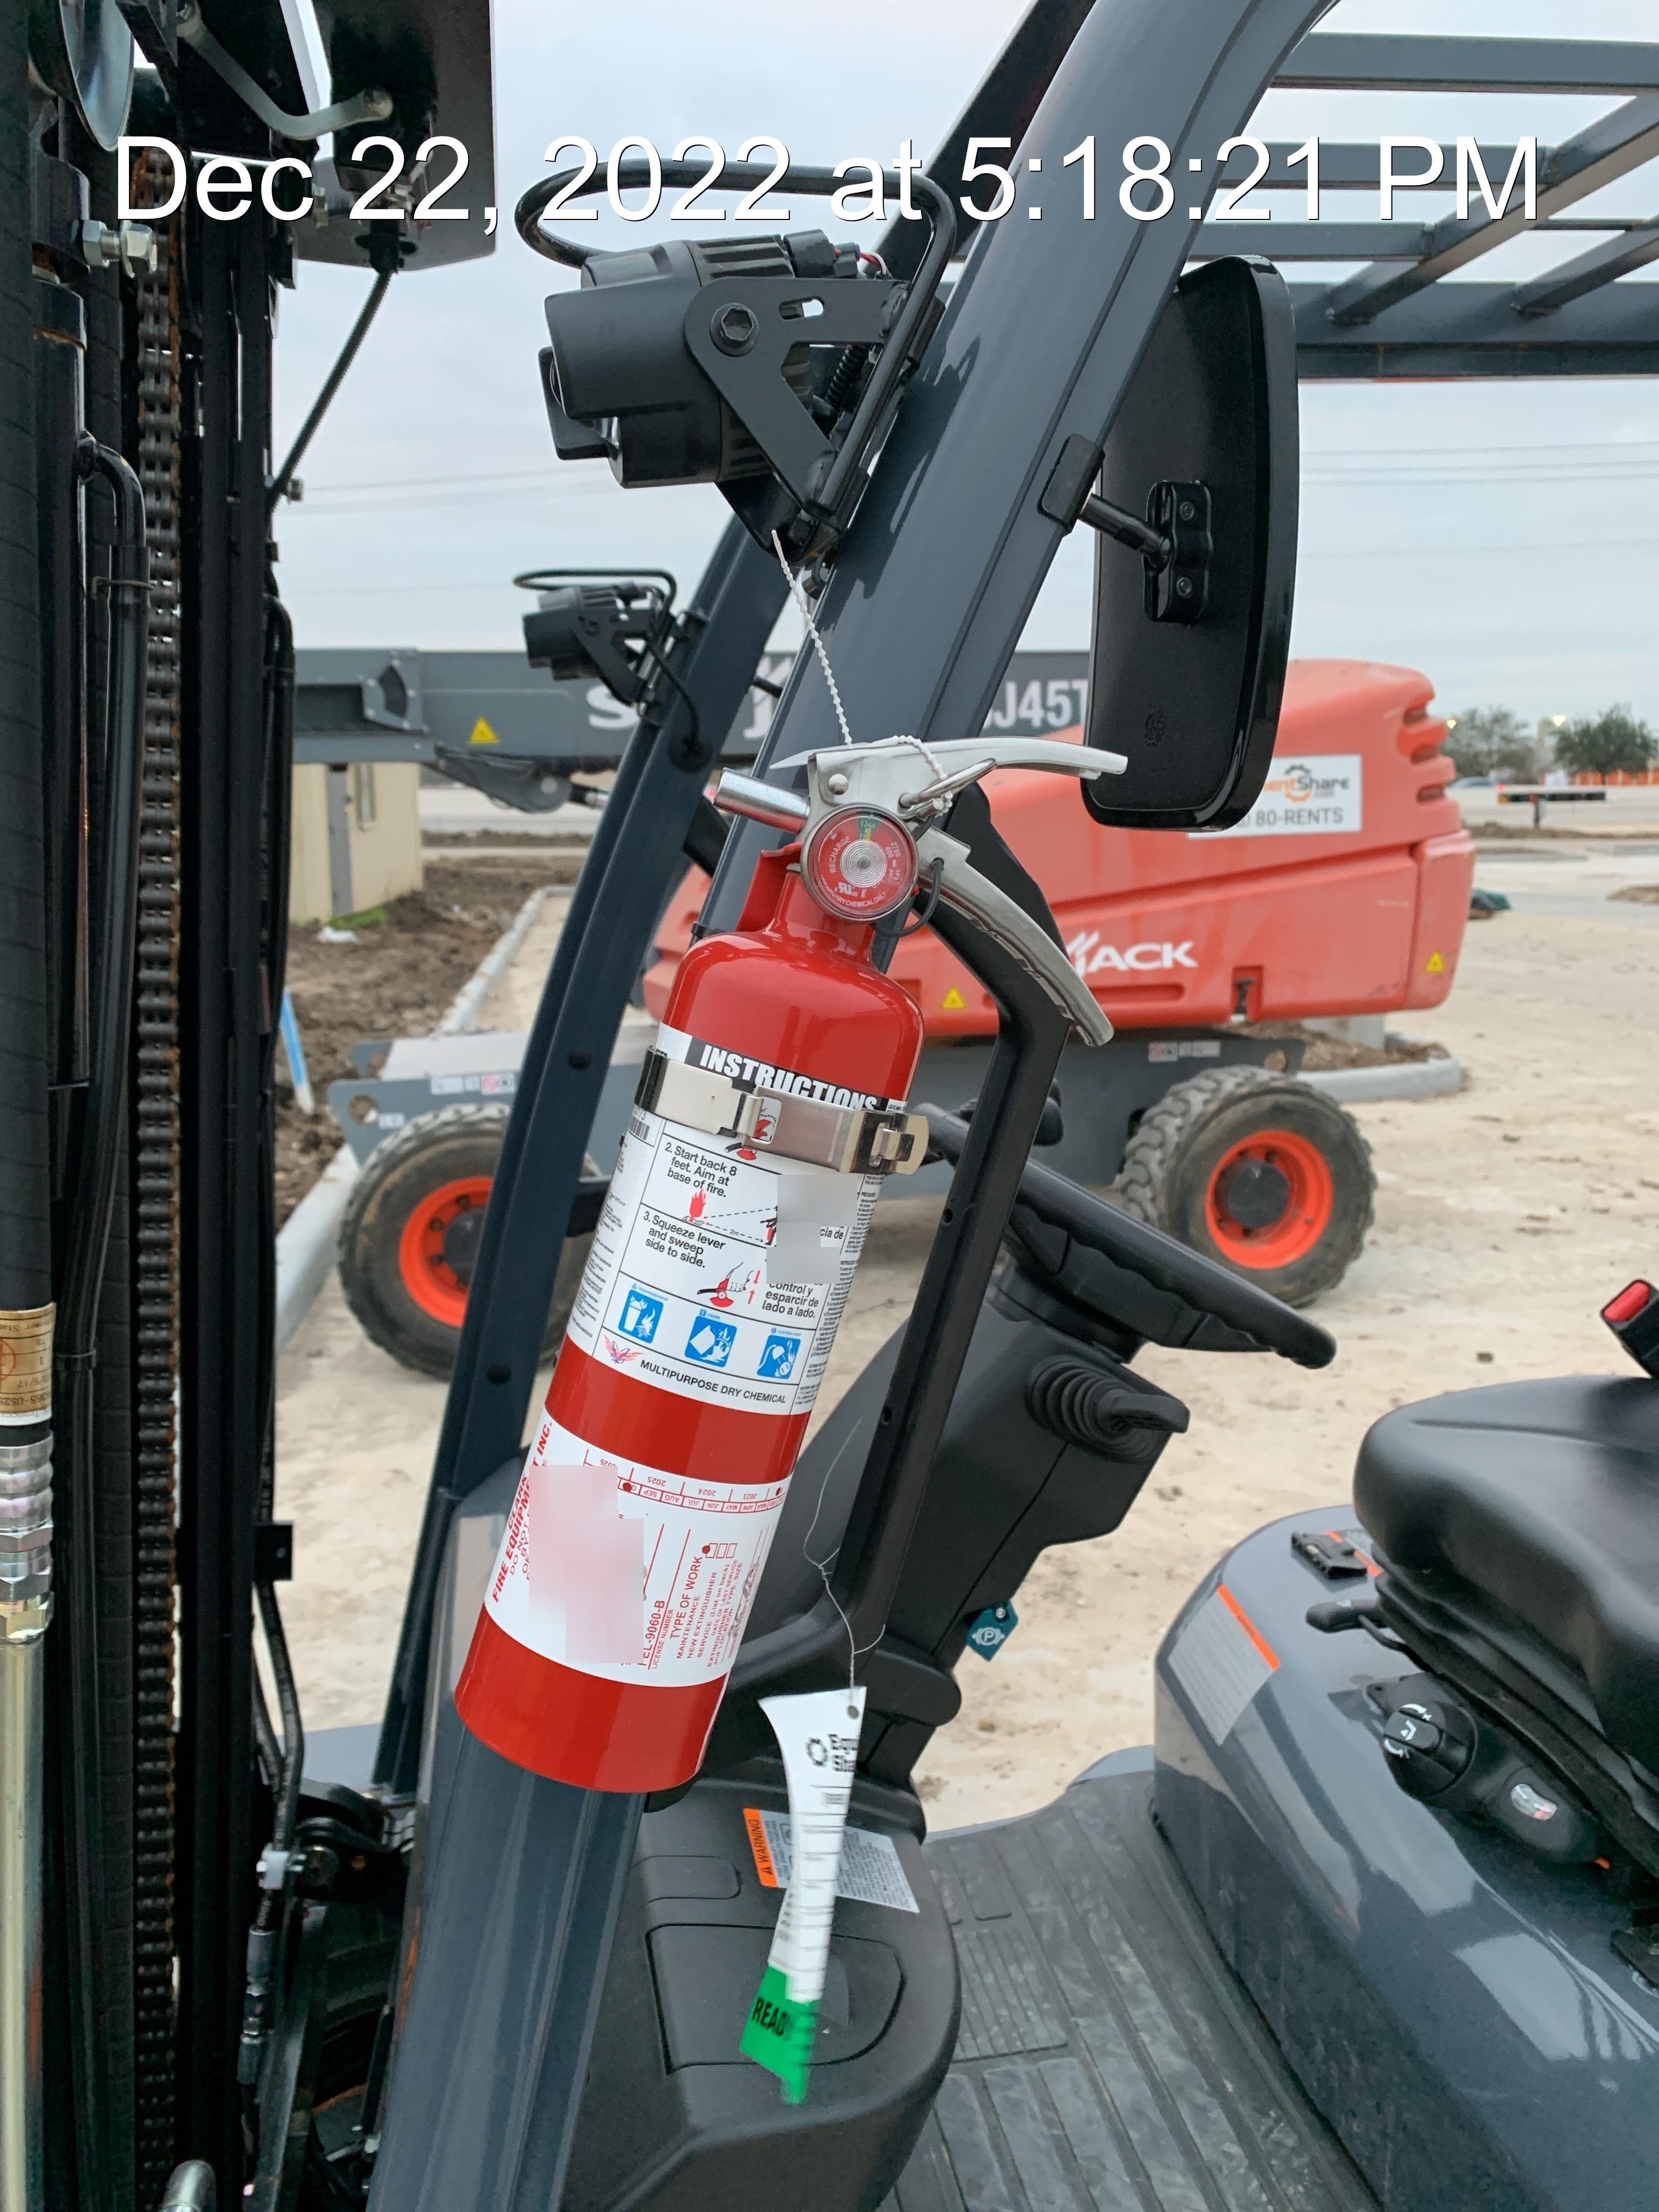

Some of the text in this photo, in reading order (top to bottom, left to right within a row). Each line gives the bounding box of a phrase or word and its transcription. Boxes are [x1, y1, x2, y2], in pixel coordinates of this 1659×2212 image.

[983, 679, 1088, 729] J45T
[829, 836, 851, 873] RECHARGE
[699, 1045, 878, 1110] INSTRUCTIONS
[665, 1142, 737, 1176] 2. Start back 8
[671, 1156, 730, 1186] feet. Aim at
[667, 1167, 726, 1198] base of fire.
[643, 1211, 651, 1222] 3.
[652, 1215, 695, 1239] Squeeze
[697, 1232, 726, 1250] lever
[648, 1228, 704, 1258] and sweep
[834, 1230, 843, 1239] de
[645, 1238, 706, 1268] side to side.
[762, 1300, 785, 1313] lado
[795, 1307, 815, 1319] lado.
[766, 1291, 819, 1307] esparcir de
[807, 1288, 813, 1297] y
[640, 1359, 719, 1392] MULTIPURPOSE
[720, 1385, 742, 1397] DRY
[743, 1391, 786, 1403] CHEMICAL
[647, 1476, 666, 1487] 2025
[664, 1494, 680, 1503] AUG
[698, 1488, 716, 1496] 2024
[492, 1422, 552, 1604] FIRE EQUIPMT INC.
[510, 1523, 528, 1575] DO NOT
[670, 1556, 703, 1639] TYPE OF WORK
[687, 1572, 717, 1658] NEW EXTINGUISHER
[697, 1564, 730, 1658] SERVICE (List on back)
[711, 1619, 720, 1636] DATE
[720, 1590, 729, 1606] LAST
[726, 1560, 737, 1588] SERVICE
[651, 1609, 674, 1669] LICENSE NUMBER
[676, 1594, 700, 1658] MAINTENANCE
[707, 1607, 729, 1667] EXTINGUISHER
[718, 1608, 733, 1650] LOCATION
[749, 1819, 770, 1863] WARNING
